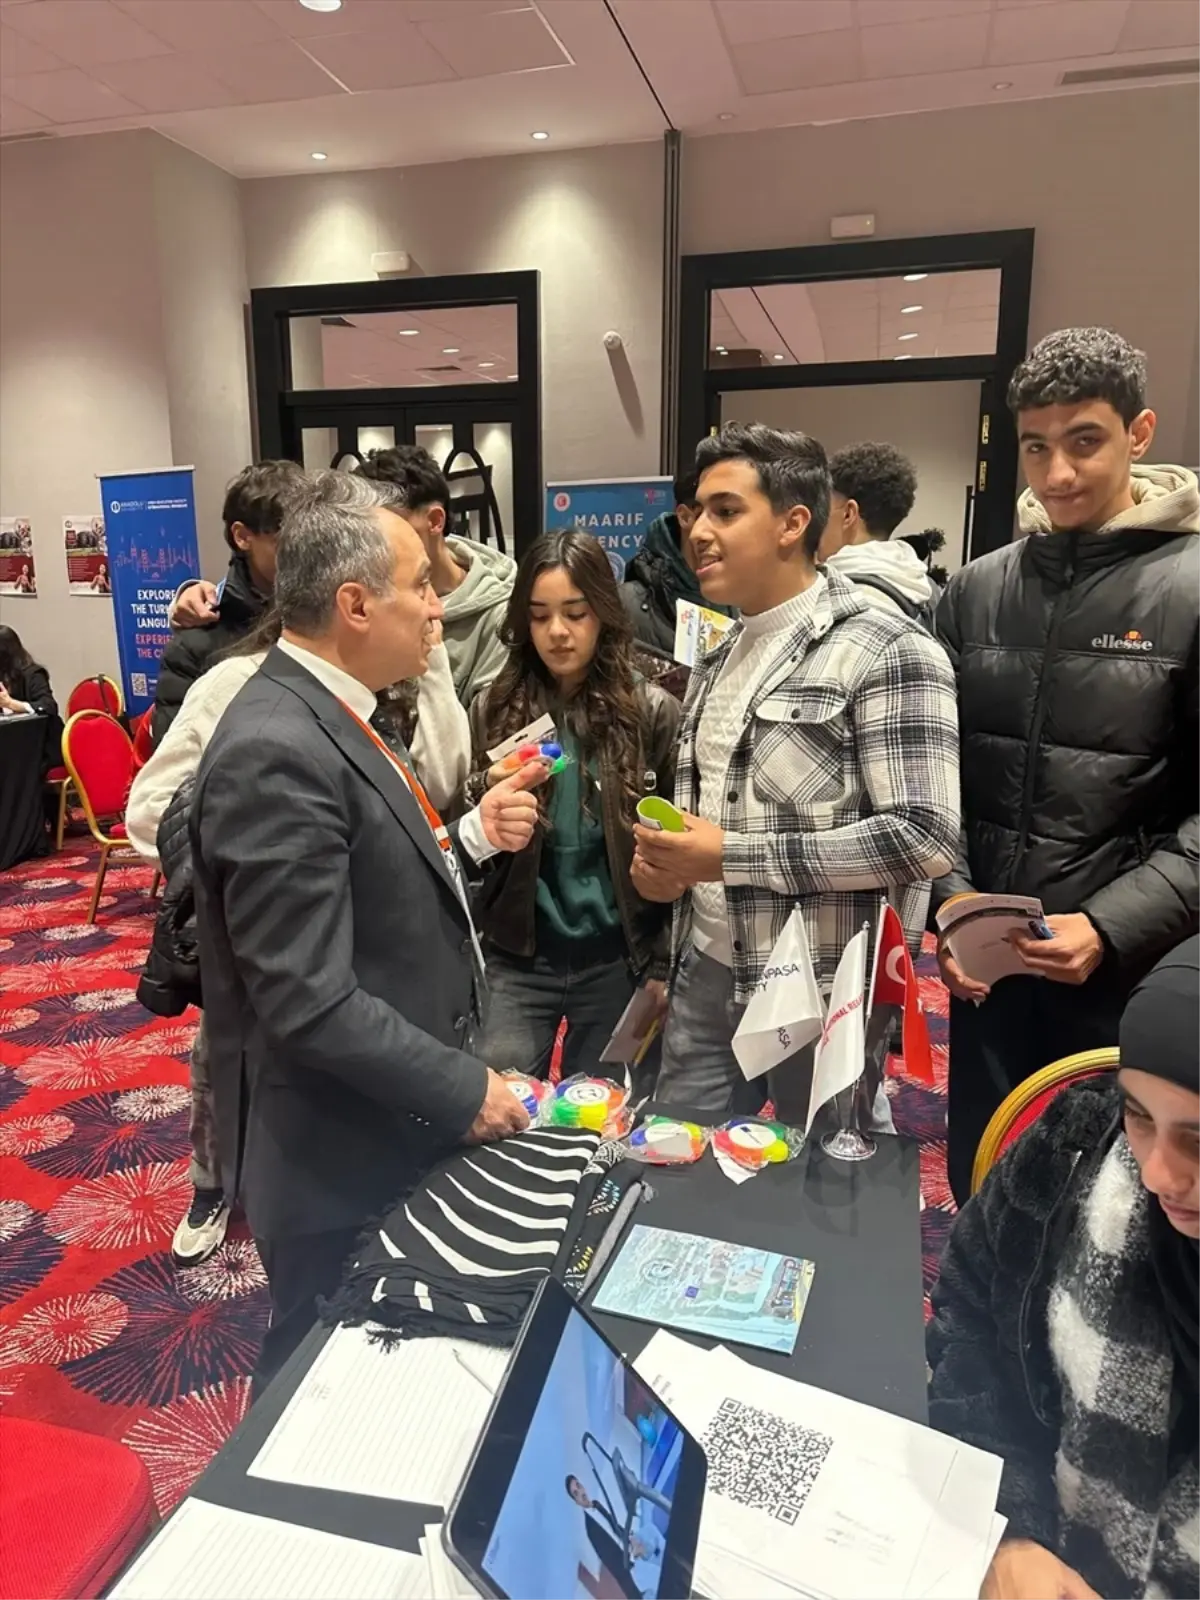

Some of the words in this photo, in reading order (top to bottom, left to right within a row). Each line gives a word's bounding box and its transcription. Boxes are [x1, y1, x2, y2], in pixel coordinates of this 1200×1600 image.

[573, 512, 644, 527] MAARIF
[592, 535, 645, 549] ENCY
[131, 603, 147, 614] THE
[1091, 633, 1153, 651] ellesse
